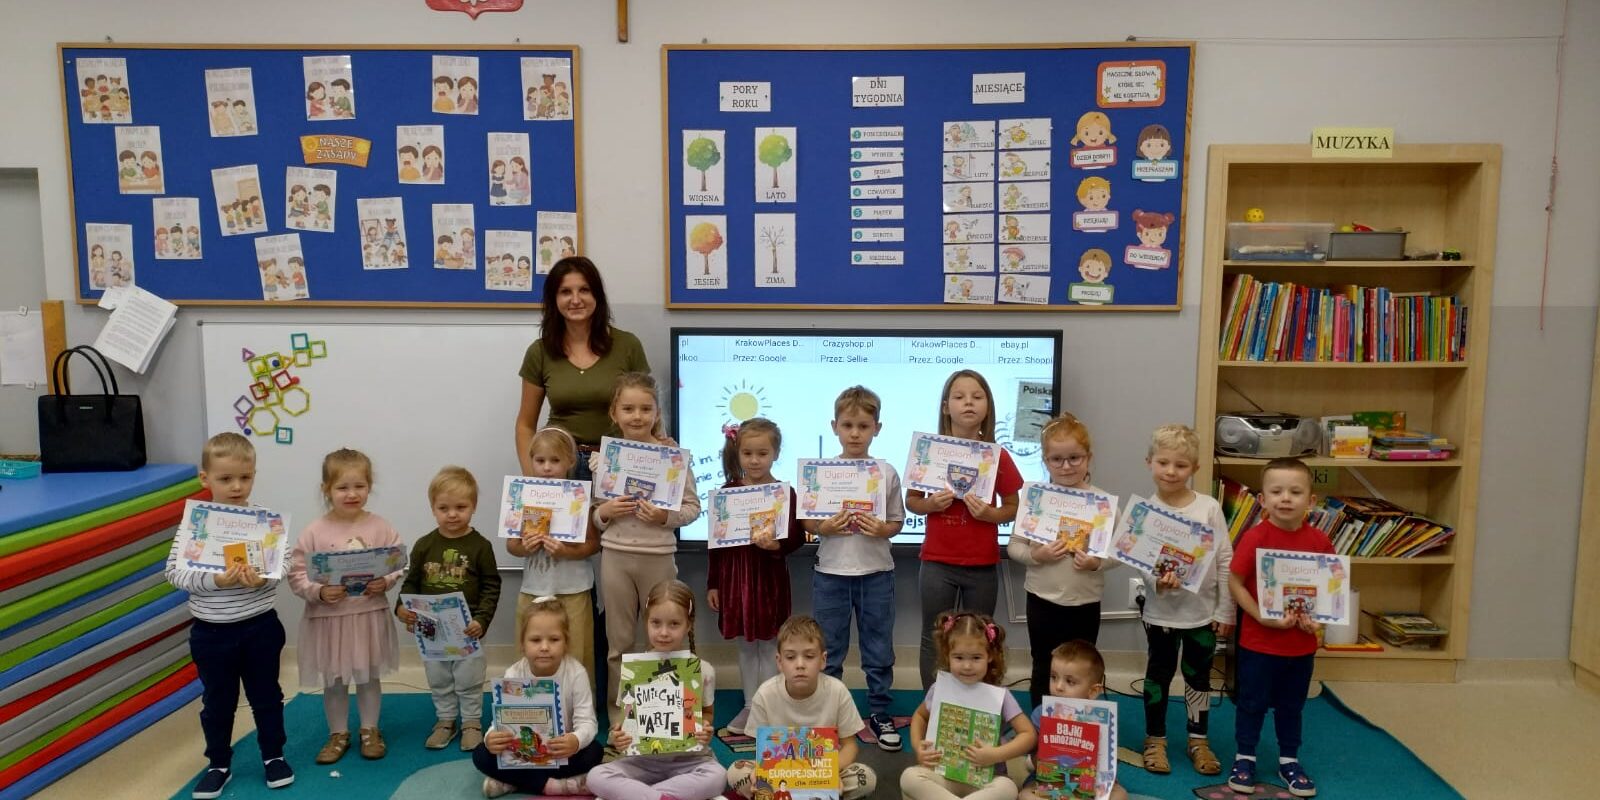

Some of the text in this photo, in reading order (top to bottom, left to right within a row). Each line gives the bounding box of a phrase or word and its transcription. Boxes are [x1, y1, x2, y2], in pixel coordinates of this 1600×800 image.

[732, 85, 758, 94] PORY
[870, 80, 887, 89] DNI
[974, 83, 1022, 94] MIESIĄCE
[854, 93, 903, 103] TYGODNIA
[732, 99, 758, 108] ROKU
[319, 138, 353, 149] NASZE
[1316, 136, 1390, 150] MUZYKA
[316, 149, 357, 160] ZASADY
[688, 194, 720, 203] WIOSNA
[765, 191, 786, 200] LATO
[693, 276, 720, 286] JESIEŃ
[765, 276, 786, 284] ZIMA
[735, 339, 791, 347] KrakowPlaces
[822, 339, 874, 349] Crazyshop.pl
[911, 340, 968, 348] KrakowPlaces
[1000, 341, 1029, 350] ebay.pl
[732, 354, 787, 363] Przez: Google
[820, 355, 844, 363] Przez:
[908, 356, 964, 364] Przez: Google
[998, 356, 1021, 364] Przez:
[627, 453, 662, 465] Dyplom
[825, 470, 859, 480] Dyplom
[530, 489, 564, 500] Dyplom
[217, 516, 257, 530] Dyplom
[1281, 564, 1319, 576] Dyplom
[639, 711, 680, 737] WARTE
[811, 758, 833, 768] UNII
[768, 768, 833, 779] EUROPEJSKIEJ
